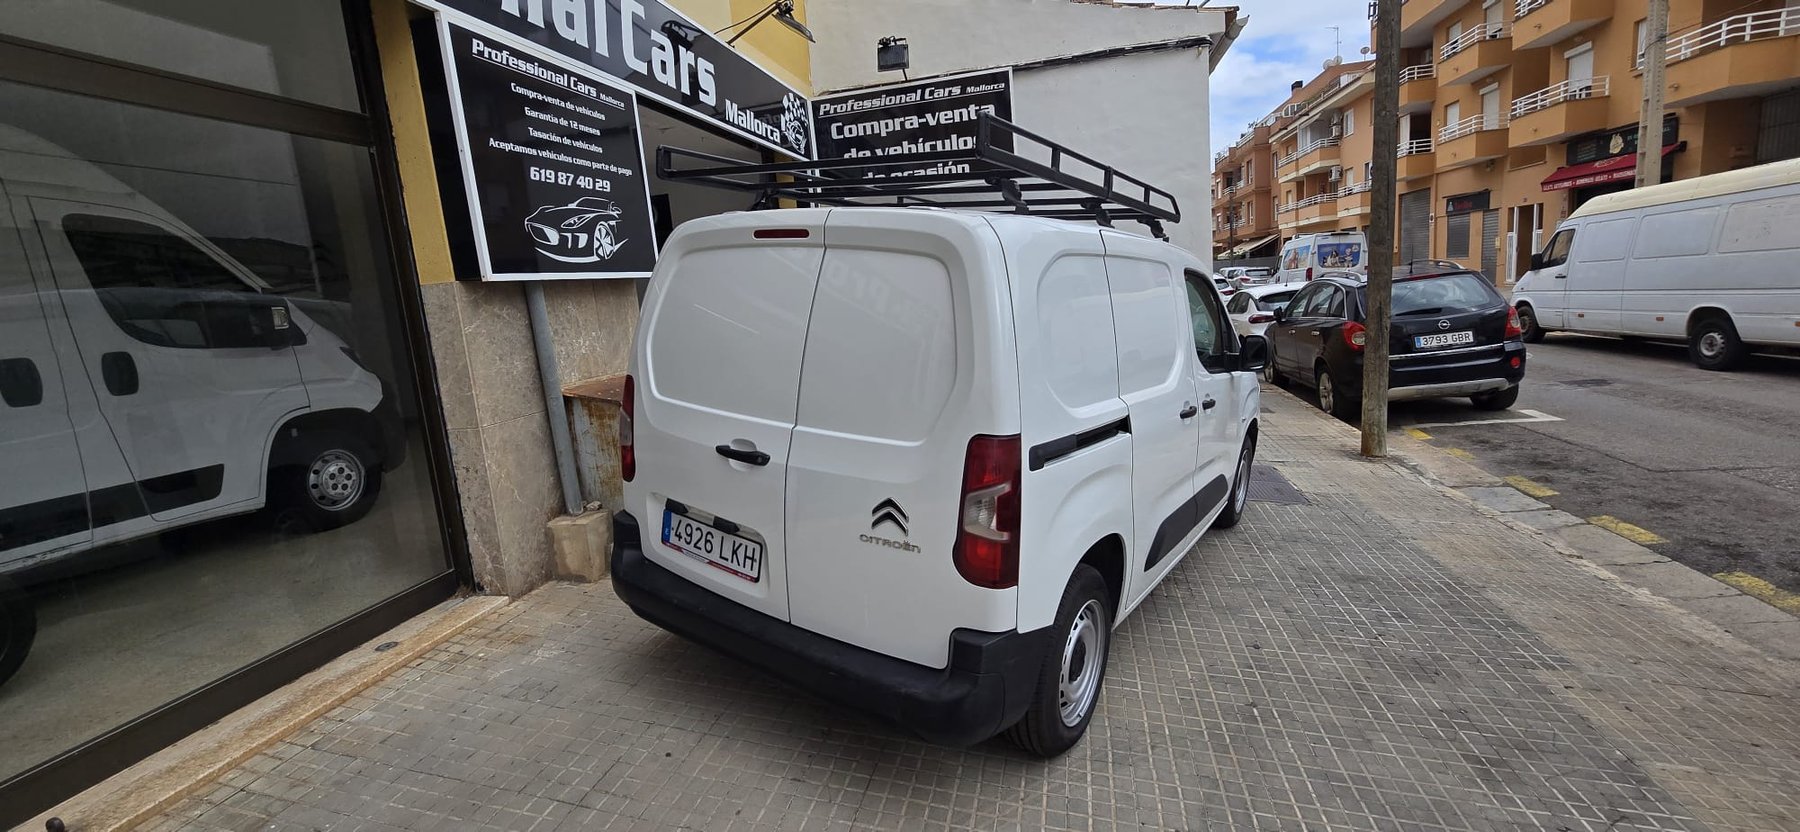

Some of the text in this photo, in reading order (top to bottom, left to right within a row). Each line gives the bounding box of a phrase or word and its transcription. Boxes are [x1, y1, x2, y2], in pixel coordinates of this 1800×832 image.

[472, 38, 625, 108] Professional Cars Mallorca
[621, 0, 716, 107] Cars
[725, 99, 780, 144] Mallorca
[511, 82, 565, 108] Compra-venta
[565, 101, 575, 111] de
[819, 82, 1005, 115] Professional Cars Mallorca
[559, 117, 569, 127] de
[569, 120, 579, 130] 12
[578, 124, 601, 136] meses
[562, 136, 572, 146] de
[489, 137, 538, 156] Aceptamos
[573, 157, 591, 168] como
[592, 160, 610, 171] parte
[609, 164, 618, 172] de
[875, 134, 976, 156] vehículo
[529, 166, 611, 193] 619 87 40 29
[1422, 333, 1471, 346] 3793 GBR
[674, 519, 756, 571] 4926 LKH
